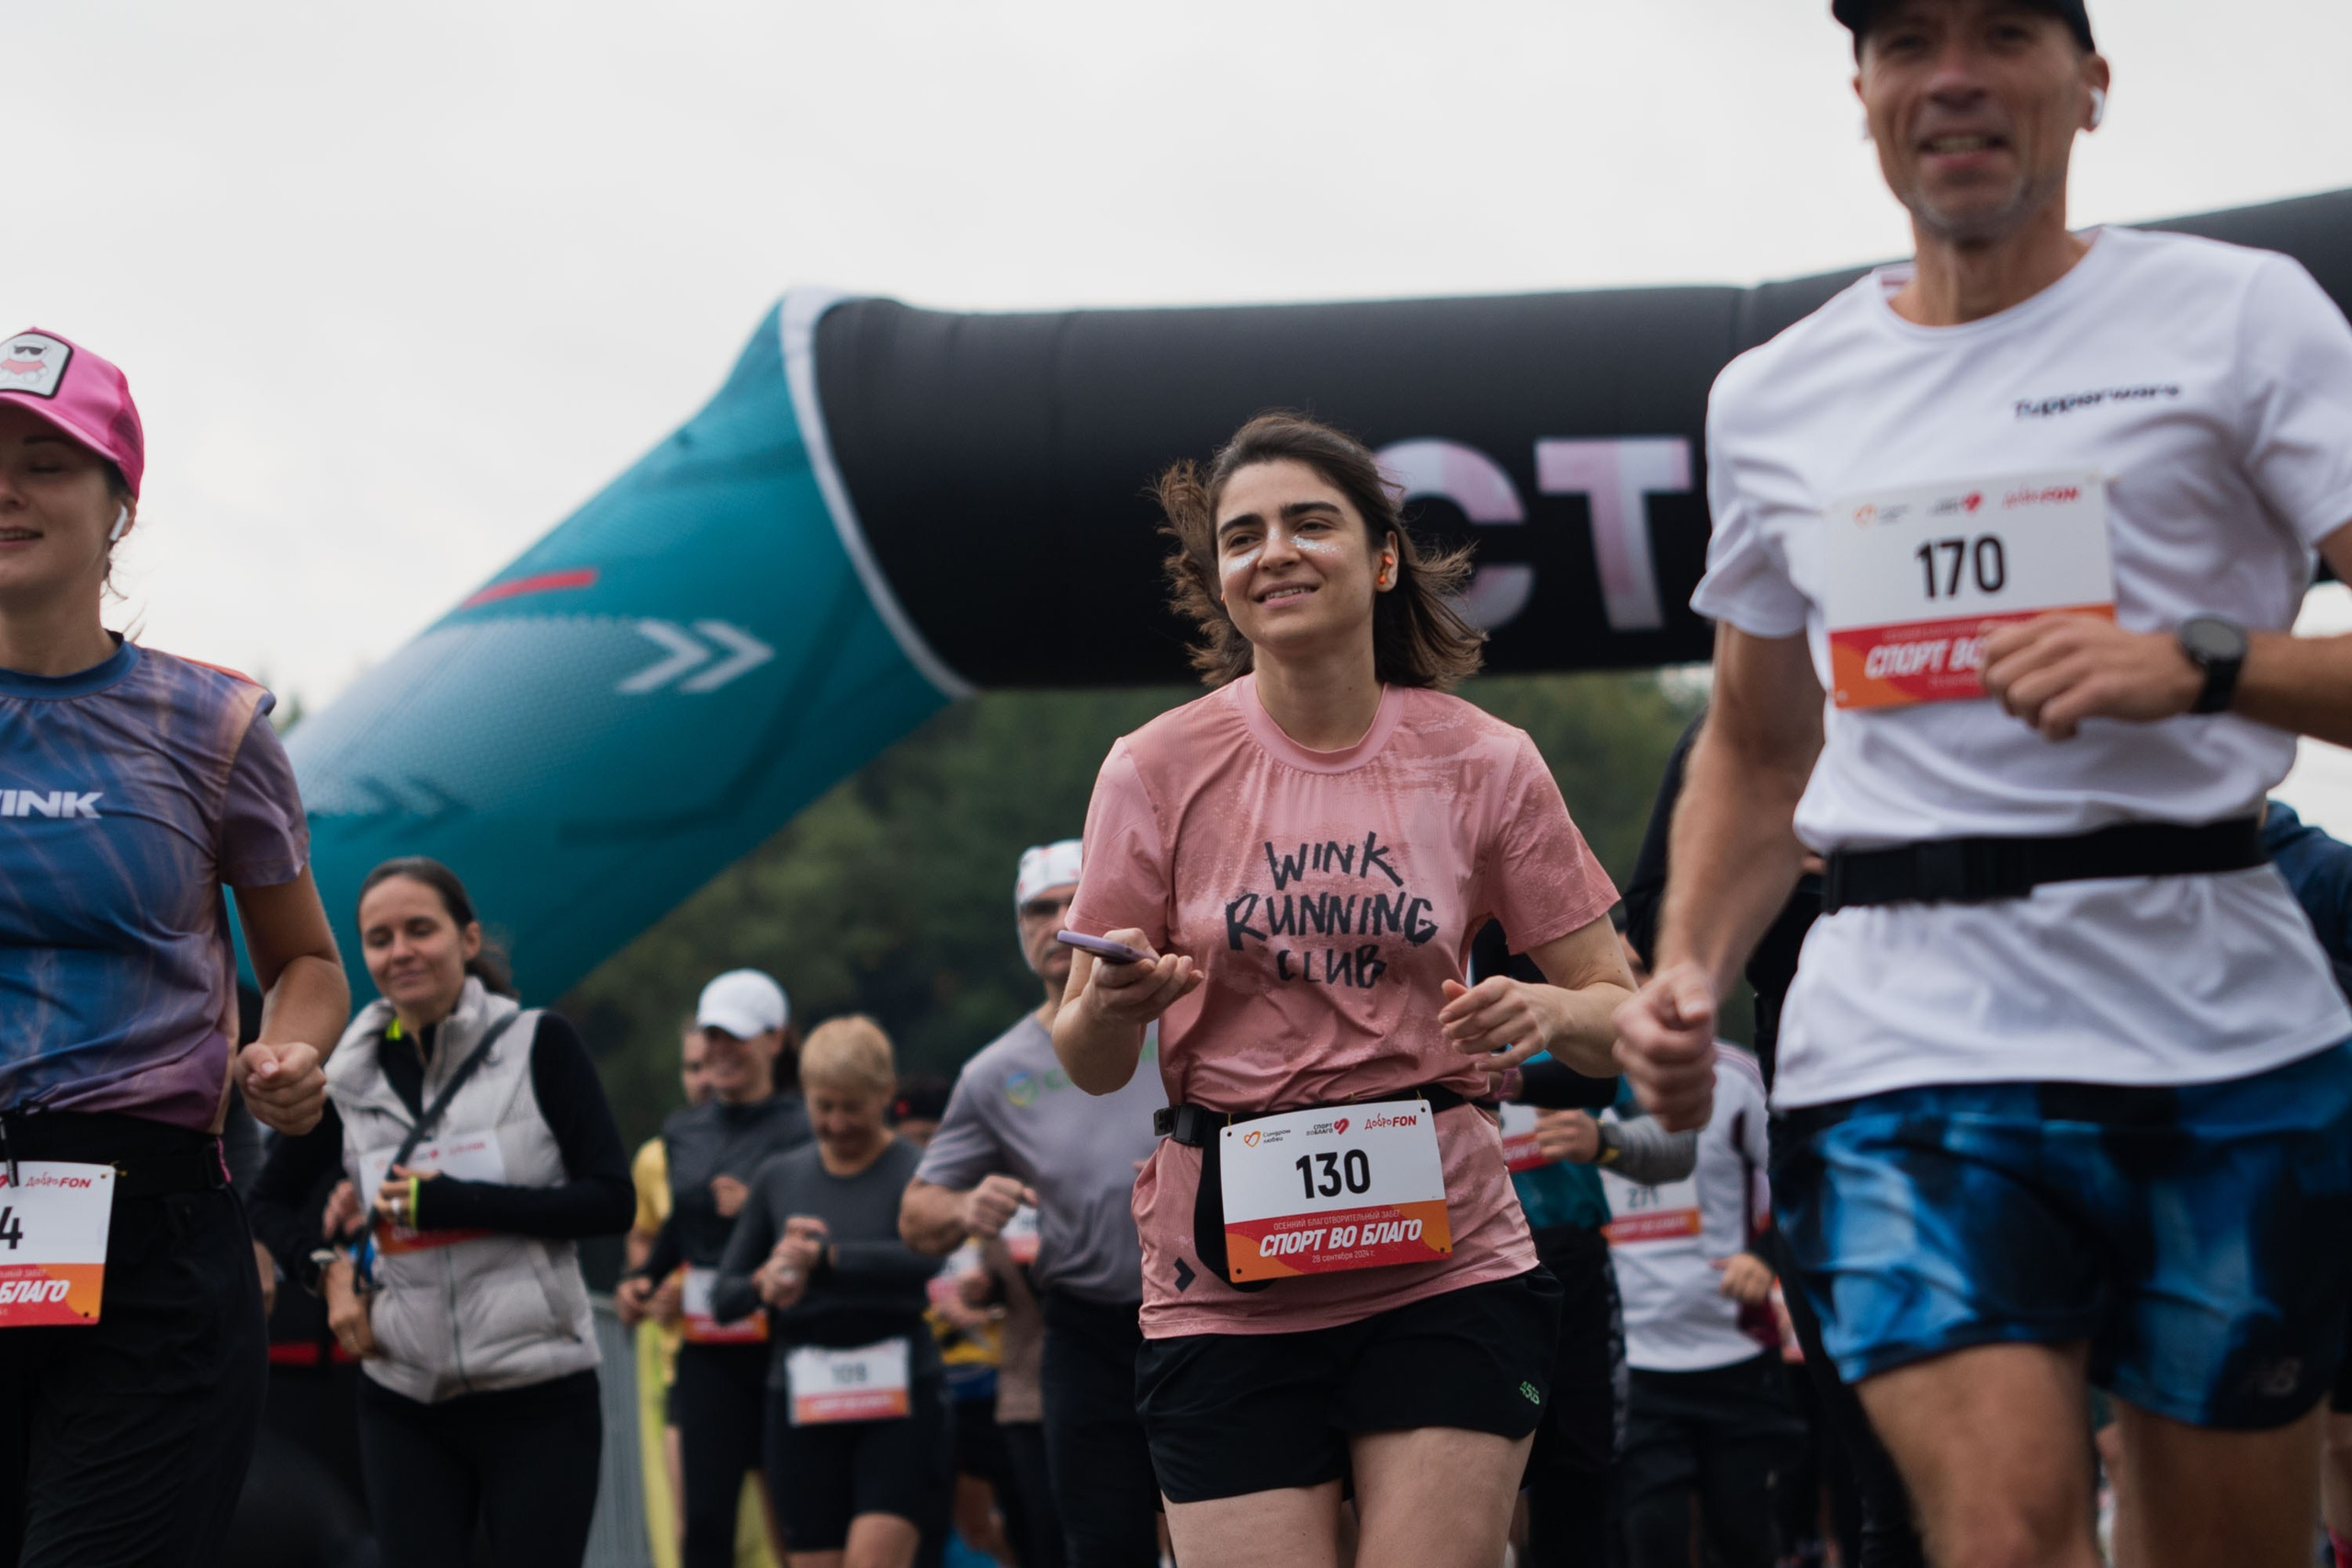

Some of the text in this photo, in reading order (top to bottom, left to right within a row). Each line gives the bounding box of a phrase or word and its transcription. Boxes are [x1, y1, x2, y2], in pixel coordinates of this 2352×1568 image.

[1916, 534, 2006, 599] 170
[1865, 638, 1951, 679] СПОРТ
[0, 789, 104, 818] INK
[1264, 831, 1404, 890] WINK
[1225, 892, 1439, 951] RUNNING
[1277, 944, 1387, 988] CLUB
[1364, 1113, 1417, 1130] ДоброFON
[1295, 1149, 1371, 1199] 130
[1259, 1218, 1423, 1258] СПОРТ ВО БЛАГО
[1273, 1209, 1401, 1231] ОСЕННИЙ БЛАГОТВОРИТЕЛЬНЫЙ ЗАБЕГ
[1312, 1254, 1321, 1264] 28
[1322, 1252, 1353, 1263] сентября
[1354, 1250, 1369, 1259] 2024
[0, 1280, 70, 1303] БЛАГО
